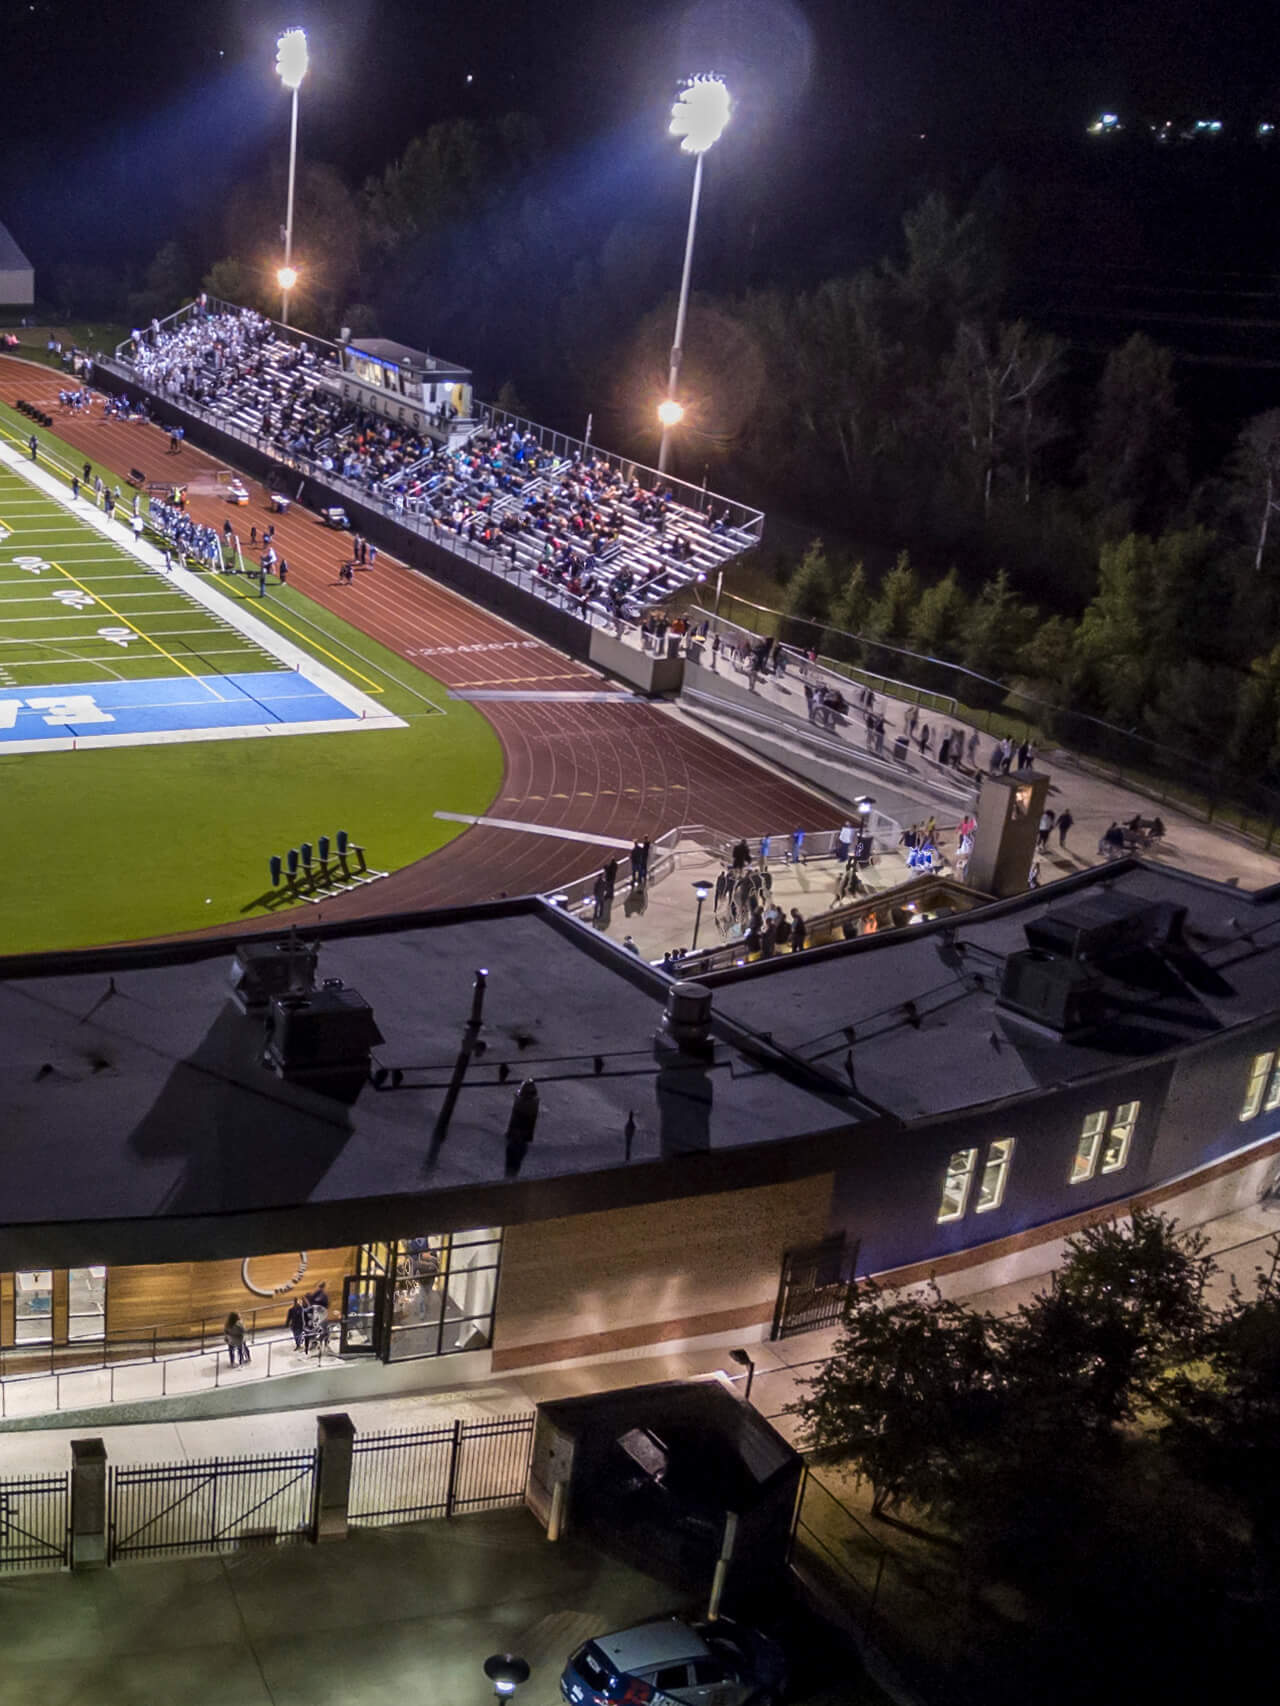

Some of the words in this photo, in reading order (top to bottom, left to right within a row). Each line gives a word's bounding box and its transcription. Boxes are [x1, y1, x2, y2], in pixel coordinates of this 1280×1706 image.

[344, 384, 419, 429] EAGLES
[52, 590, 96, 607] 20
[97, 627, 139, 645] 10
